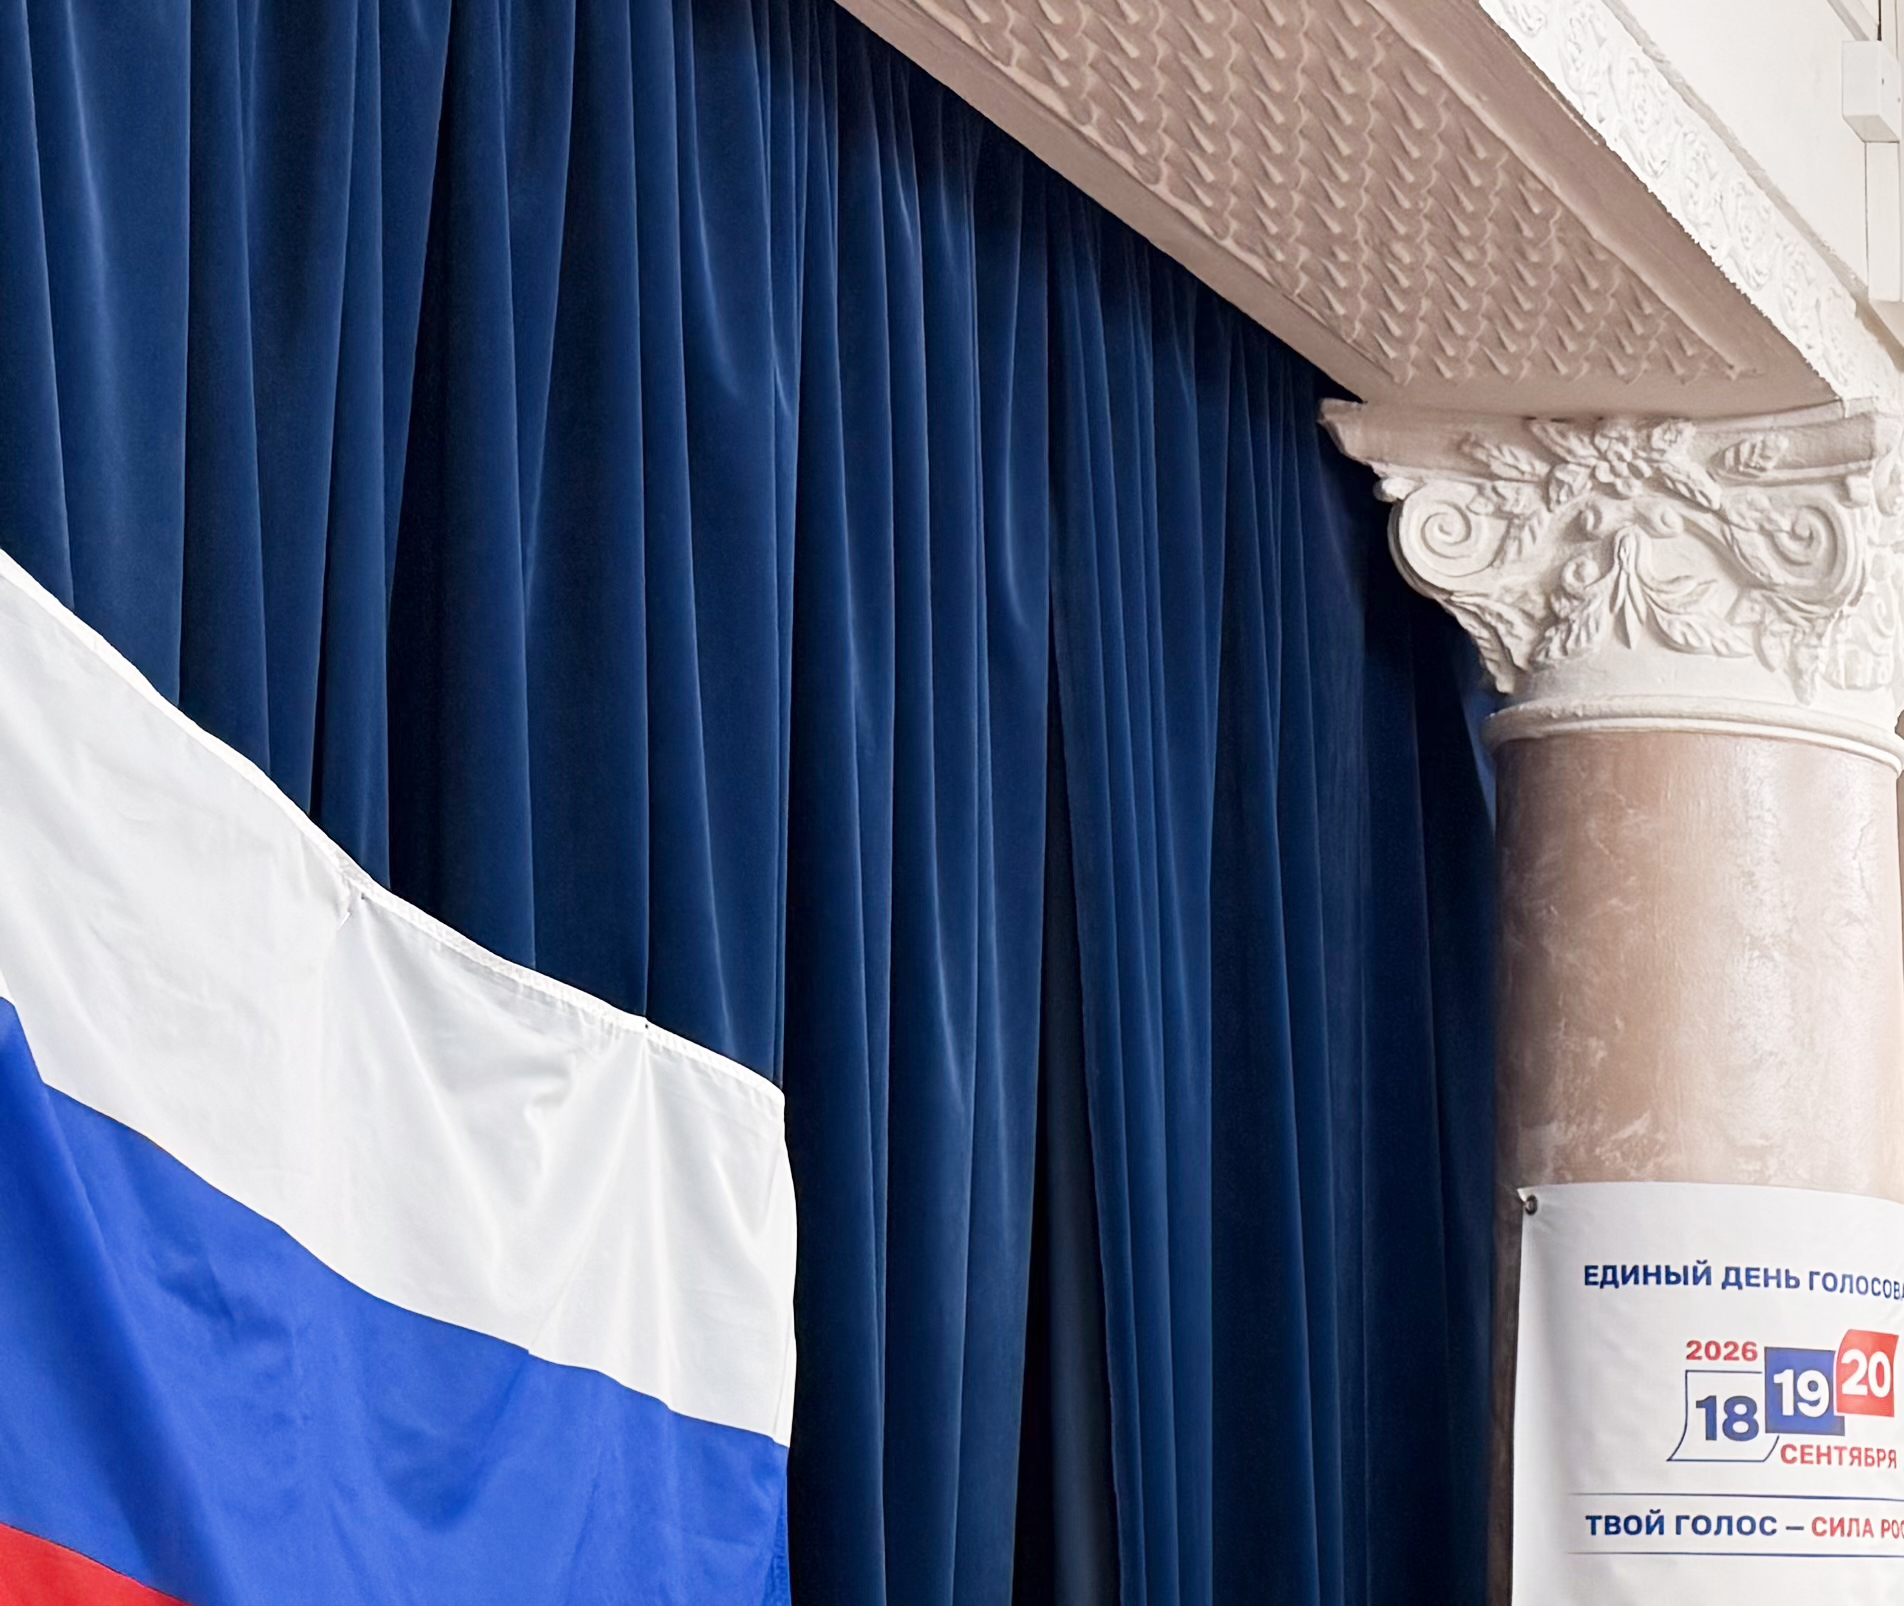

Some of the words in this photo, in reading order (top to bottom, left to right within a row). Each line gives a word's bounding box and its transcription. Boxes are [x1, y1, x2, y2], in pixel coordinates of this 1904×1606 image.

[1583, 1259, 1712, 1290] ЕДИНЫЙ
[1720, 1266, 1801, 1291] ДЕНЬ
[1685, 1339, 1758, 1362] 2026
[1695, 1394, 1760, 1442] 18
[1773, 1368, 1830, 1418] 19
[1841, 1349, 1893, 1398] 20
[1779, 1443, 1898, 1470] СЕНТЯБРЯ
[1585, 1508, 1665, 1537] ТВОЙ
[1675, 1513, 1778, 1538] ГОЛОС
[1811, 1516, 1875, 1539] СИЛА
